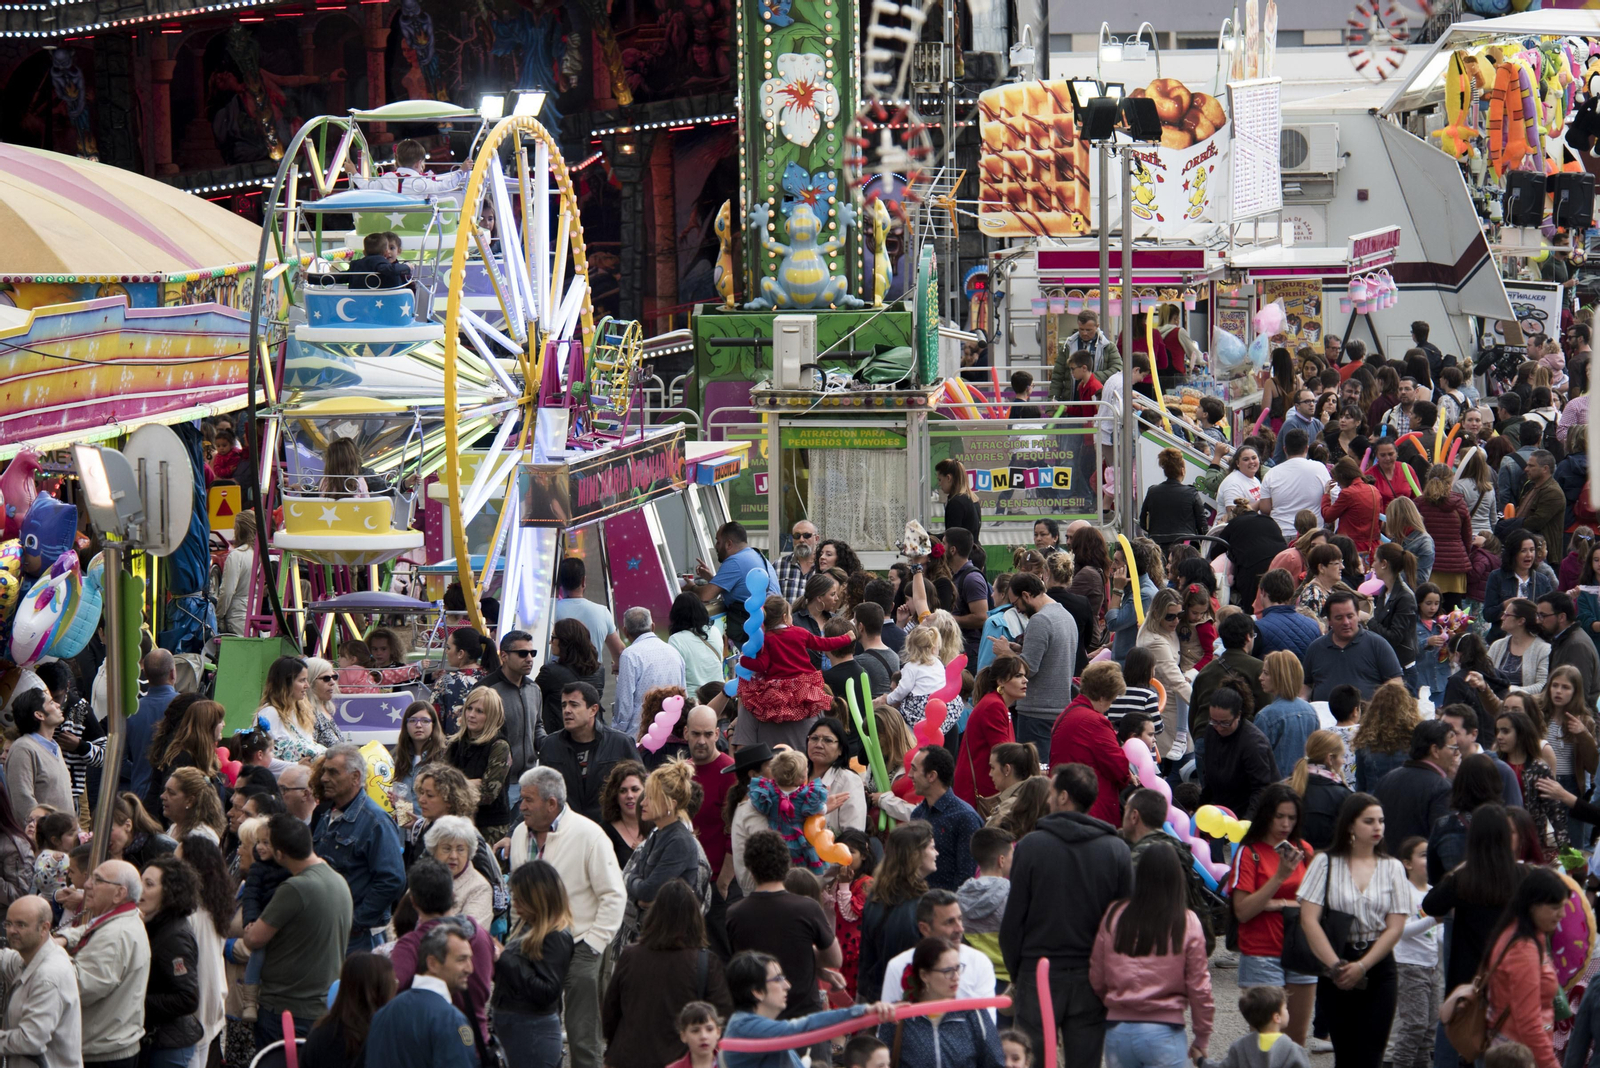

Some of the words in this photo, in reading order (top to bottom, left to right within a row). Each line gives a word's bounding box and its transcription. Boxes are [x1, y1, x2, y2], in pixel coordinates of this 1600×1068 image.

[860, 429, 885, 438] PARA
[788, 438, 842, 447] PEQUEÑOS
[845, 438, 851, 446] Y
[853, 438, 900, 447] MAYORES
[1032, 439, 1059, 449] PARA
[955, 452, 1004, 462] MAYORES
[1007, 453, 1014, 461] Y
[1016, 449, 1074, 461] PEQUEÑOS
[578, 474, 599, 508] MINI
[600, 463, 629, 499] NORIA
[967, 469, 1070, 491] JUMPING
[999, 498, 1085, 509] SENSACIONES!!!
